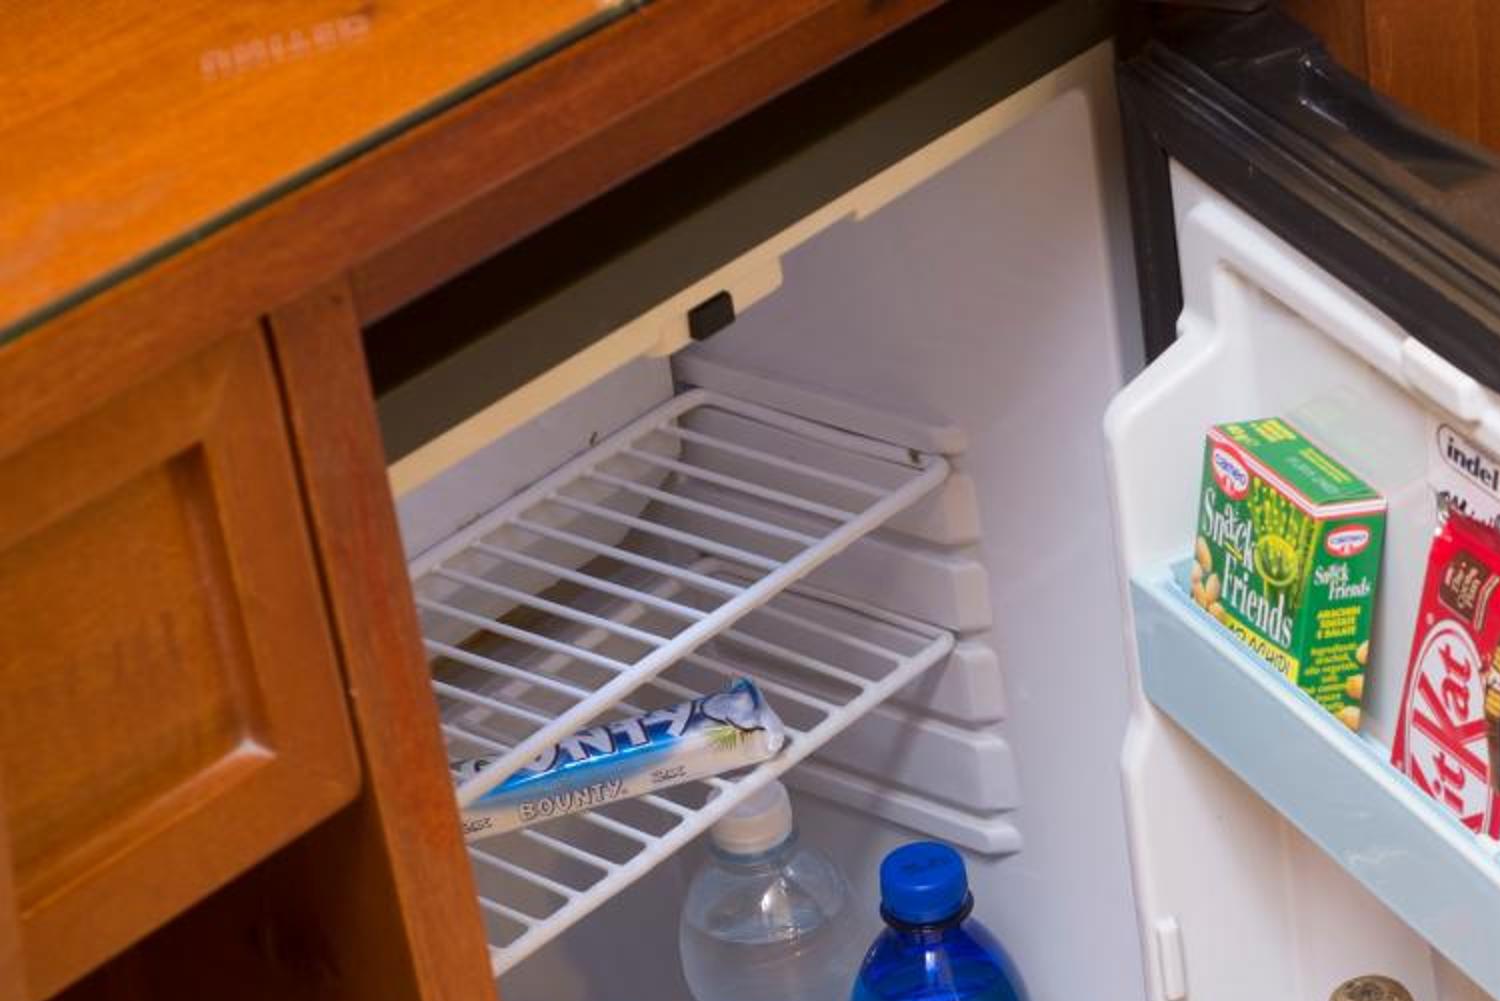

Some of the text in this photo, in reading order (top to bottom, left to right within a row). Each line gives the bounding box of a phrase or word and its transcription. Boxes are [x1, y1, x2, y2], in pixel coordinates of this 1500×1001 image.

[1446, 437, 1500, 492] indel
[1203, 487, 1257, 573] Snack
[1222, 545, 1293, 649] Friends
[519, 778, 624, 823] BOUNTY
